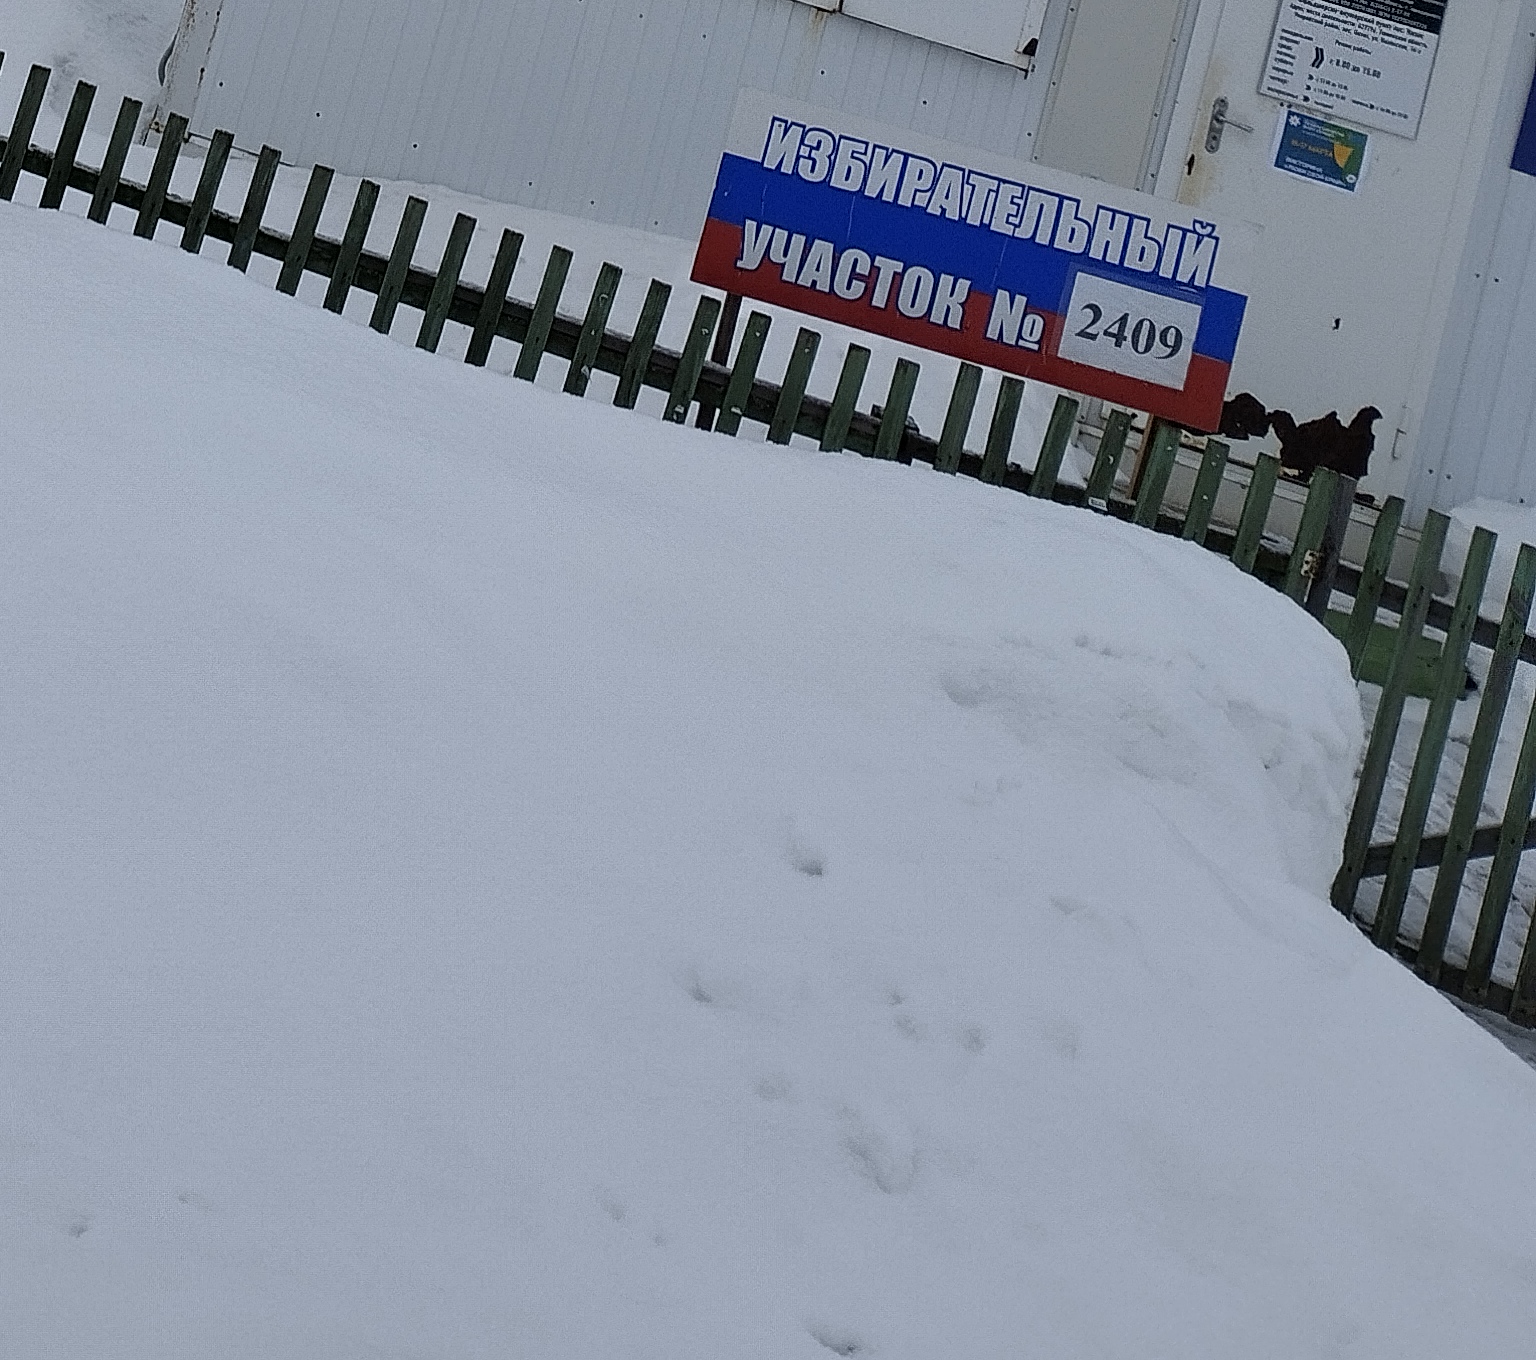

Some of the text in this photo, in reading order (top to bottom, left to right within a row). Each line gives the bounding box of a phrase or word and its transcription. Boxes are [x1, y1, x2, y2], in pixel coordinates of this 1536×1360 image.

[764, 116, 1218, 287] ИЗБИРАТЕЛЬНЫЙ
[736, 219, 1183, 360] УЧАСТОК № 2409
